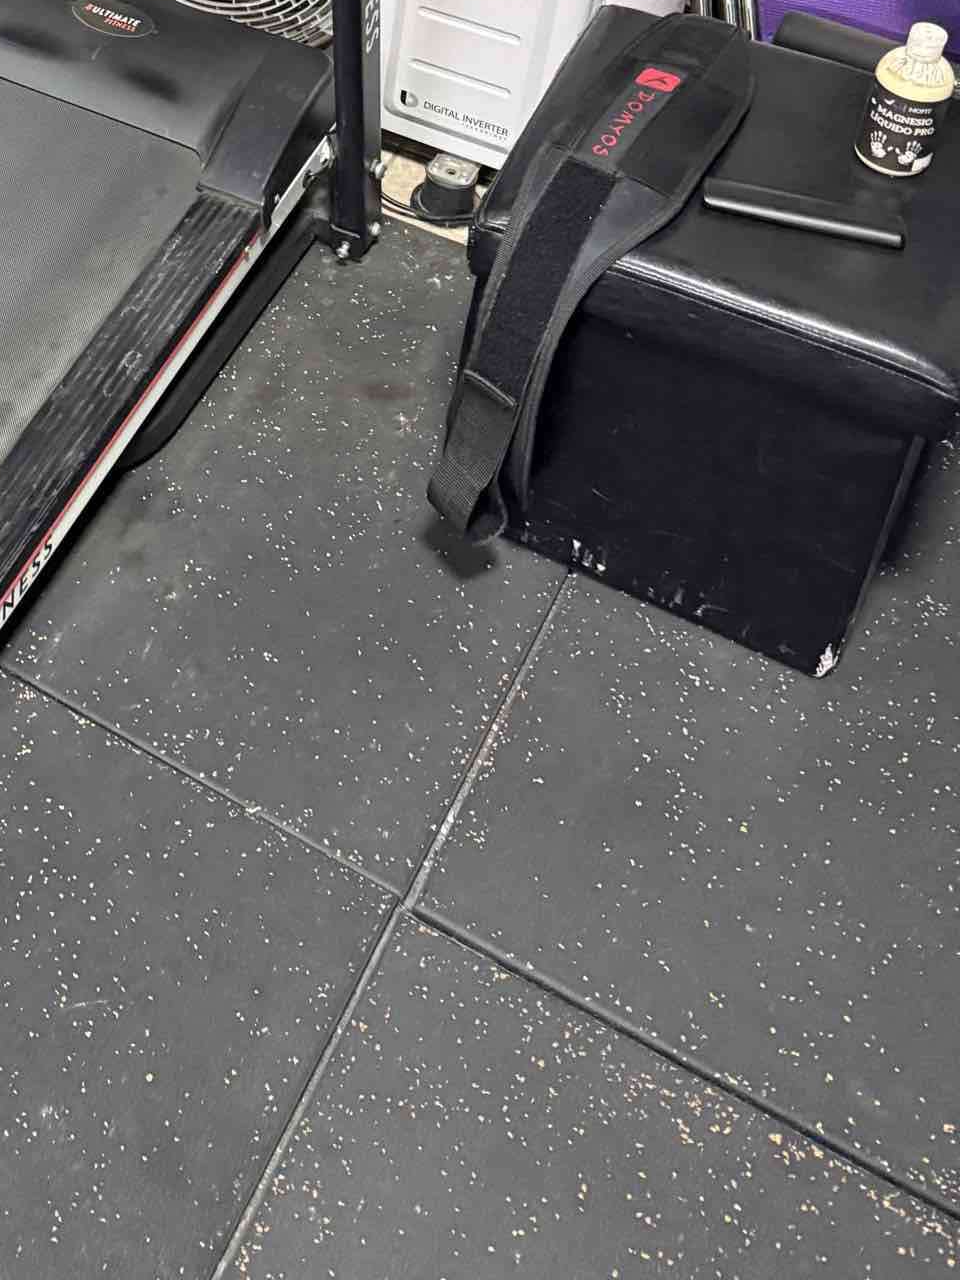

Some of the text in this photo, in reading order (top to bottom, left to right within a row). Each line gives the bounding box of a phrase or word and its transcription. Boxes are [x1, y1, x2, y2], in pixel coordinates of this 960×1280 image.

[92, 5, 142, 27] ULTIMATE
[103, 18, 137, 32] FITNESS
[423, 100, 460, 121] DIGITAL
[462, 114, 509, 136] INVERTER
[592, 91, 656, 156] DOMYOS
[877, 104, 934, 127] MAGNESIO
[913, 126, 935, 136] PRO
